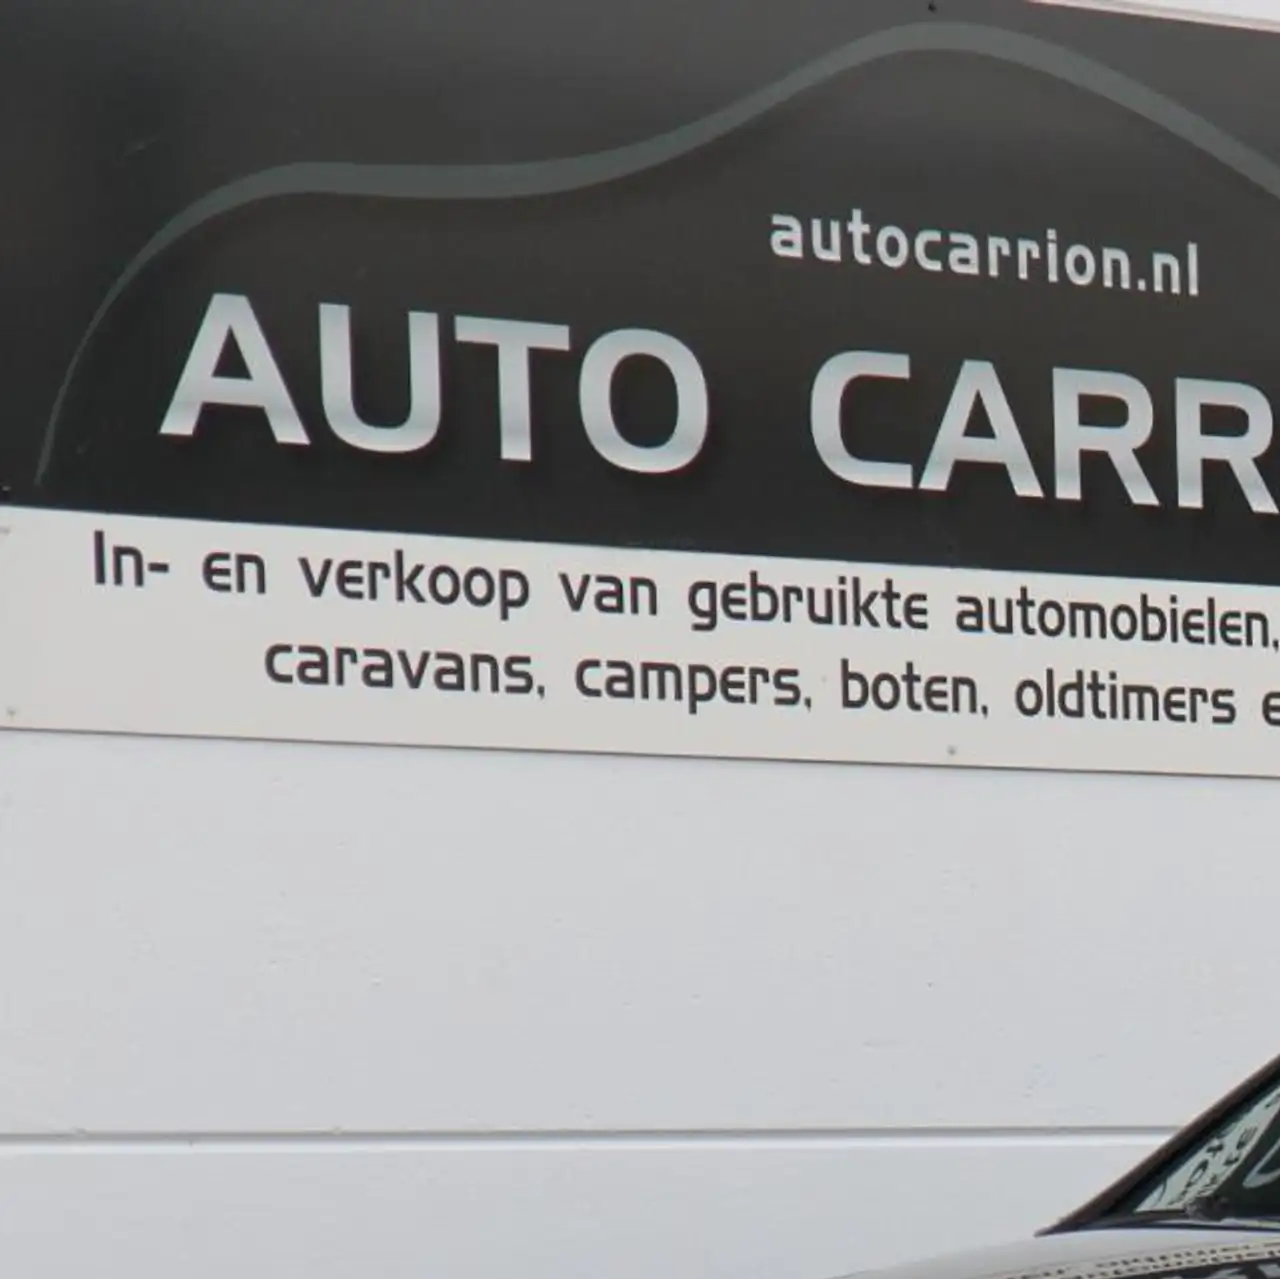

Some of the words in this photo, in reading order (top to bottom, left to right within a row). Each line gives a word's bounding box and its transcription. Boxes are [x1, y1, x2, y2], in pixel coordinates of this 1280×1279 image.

[770, 208, 1199, 296] autocarrion.nl
[159, 293, 709, 474] AUTO
[94, 530, 169, 587] In-
[202, 552, 266, 594] en
[298, 549, 530, 621] verkoop
[559, 572, 658, 616] van
[687, 570, 929, 632] gebruikte
[955, 586, 1280, 653] automobielen,
[265, 644, 546, 700] caravans,
[575, 659, 812, 715] campers,
[841, 658, 989, 718] boten,
[1015, 668, 1237, 725] oldtimers
